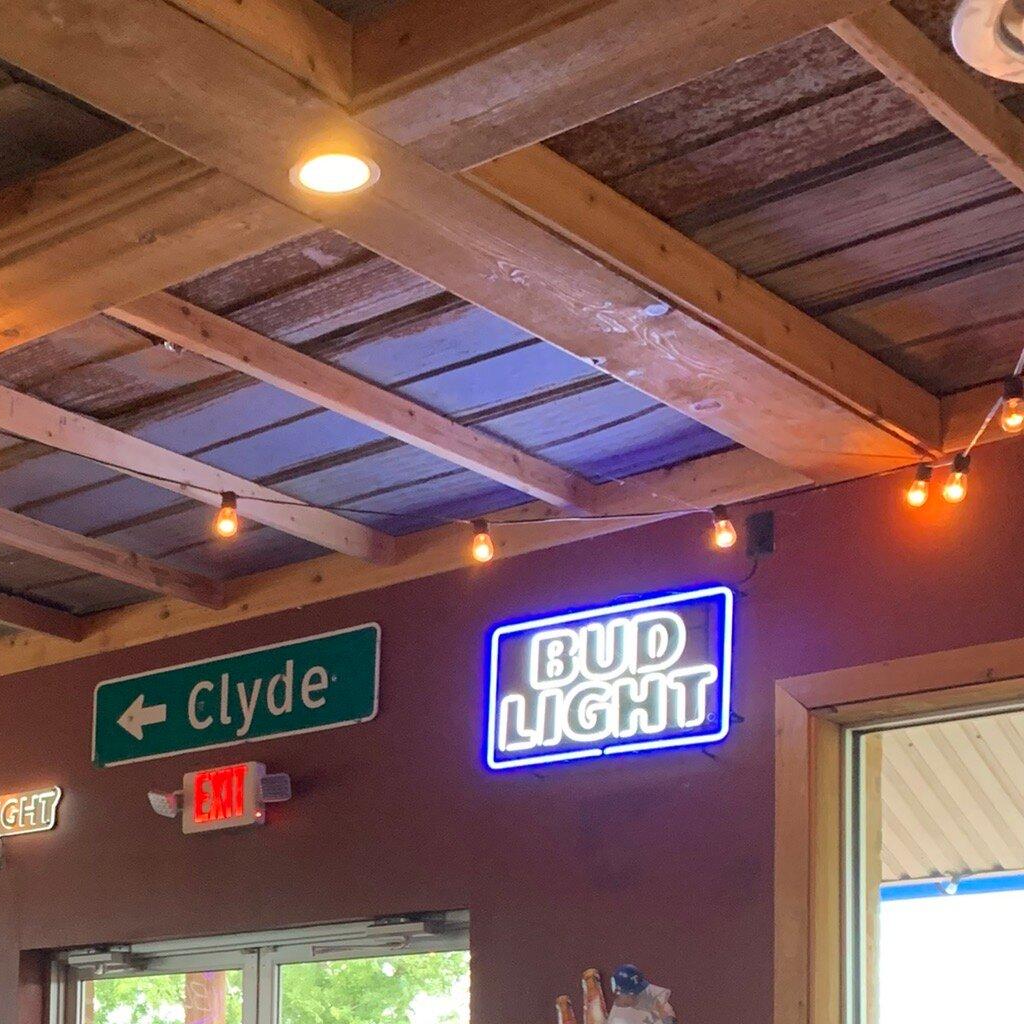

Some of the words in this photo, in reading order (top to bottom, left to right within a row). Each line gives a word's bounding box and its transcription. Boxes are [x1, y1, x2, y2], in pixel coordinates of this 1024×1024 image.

[530, 611, 687, 691] BUD
[187, 659, 329, 737] Clyde
[497, 664, 719, 752] LIGHT
[194, 763, 249, 824] EXIT
